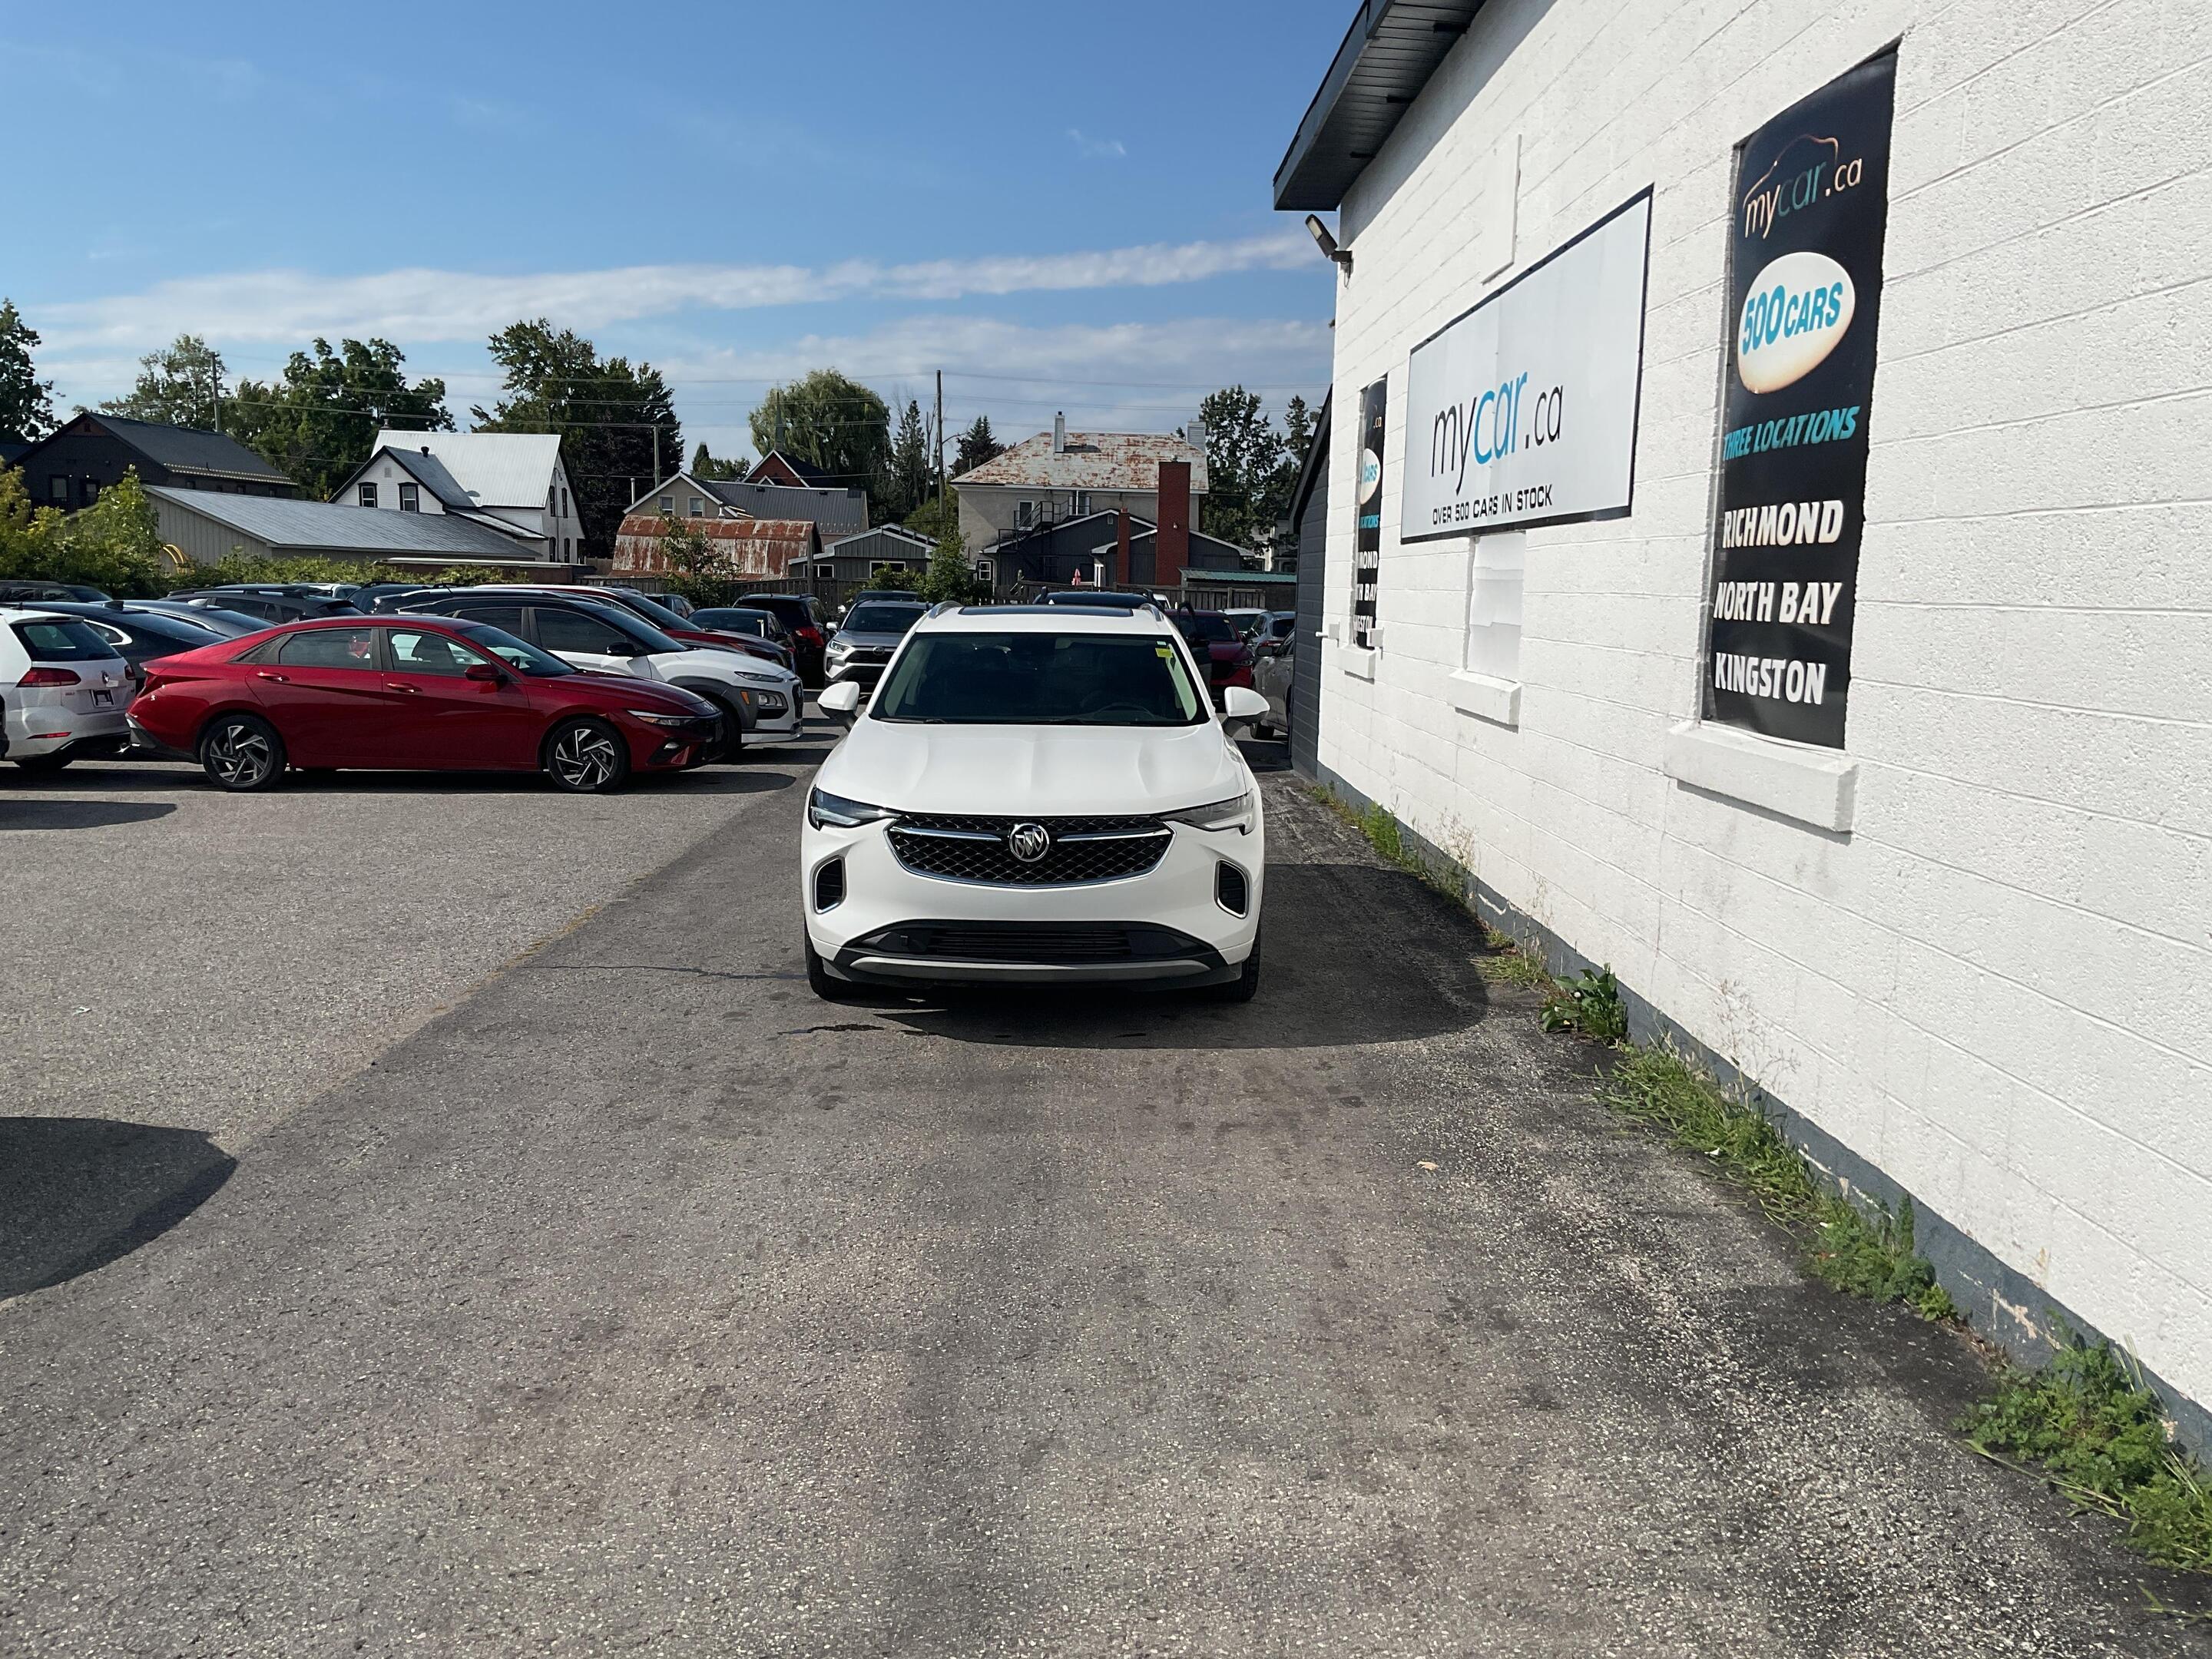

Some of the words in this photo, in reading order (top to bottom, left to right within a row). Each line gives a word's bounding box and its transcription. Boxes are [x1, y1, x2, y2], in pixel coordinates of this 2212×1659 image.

[1744, 157, 1863, 240] mycar.ca
[1431, 371, 1564, 496] mycar.ca
[1722, 422, 1753, 461] THREE
[1753, 406, 1860, 453] LOCATIONS
[1432, 505, 1452, 526] OVER
[1455, 502, 1470, 521] 500
[1472, 495, 1498, 518] CARS
[1502, 492, 1512, 514] IN
[1516, 484, 1553, 511] STOCK
[1722, 500, 1843, 548] RICHMOND
[1713, 581, 1776, 623] NORTH
[1778, 582, 1843, 624] BAY
[1714, 651, 1826, 705] KINGSTON
